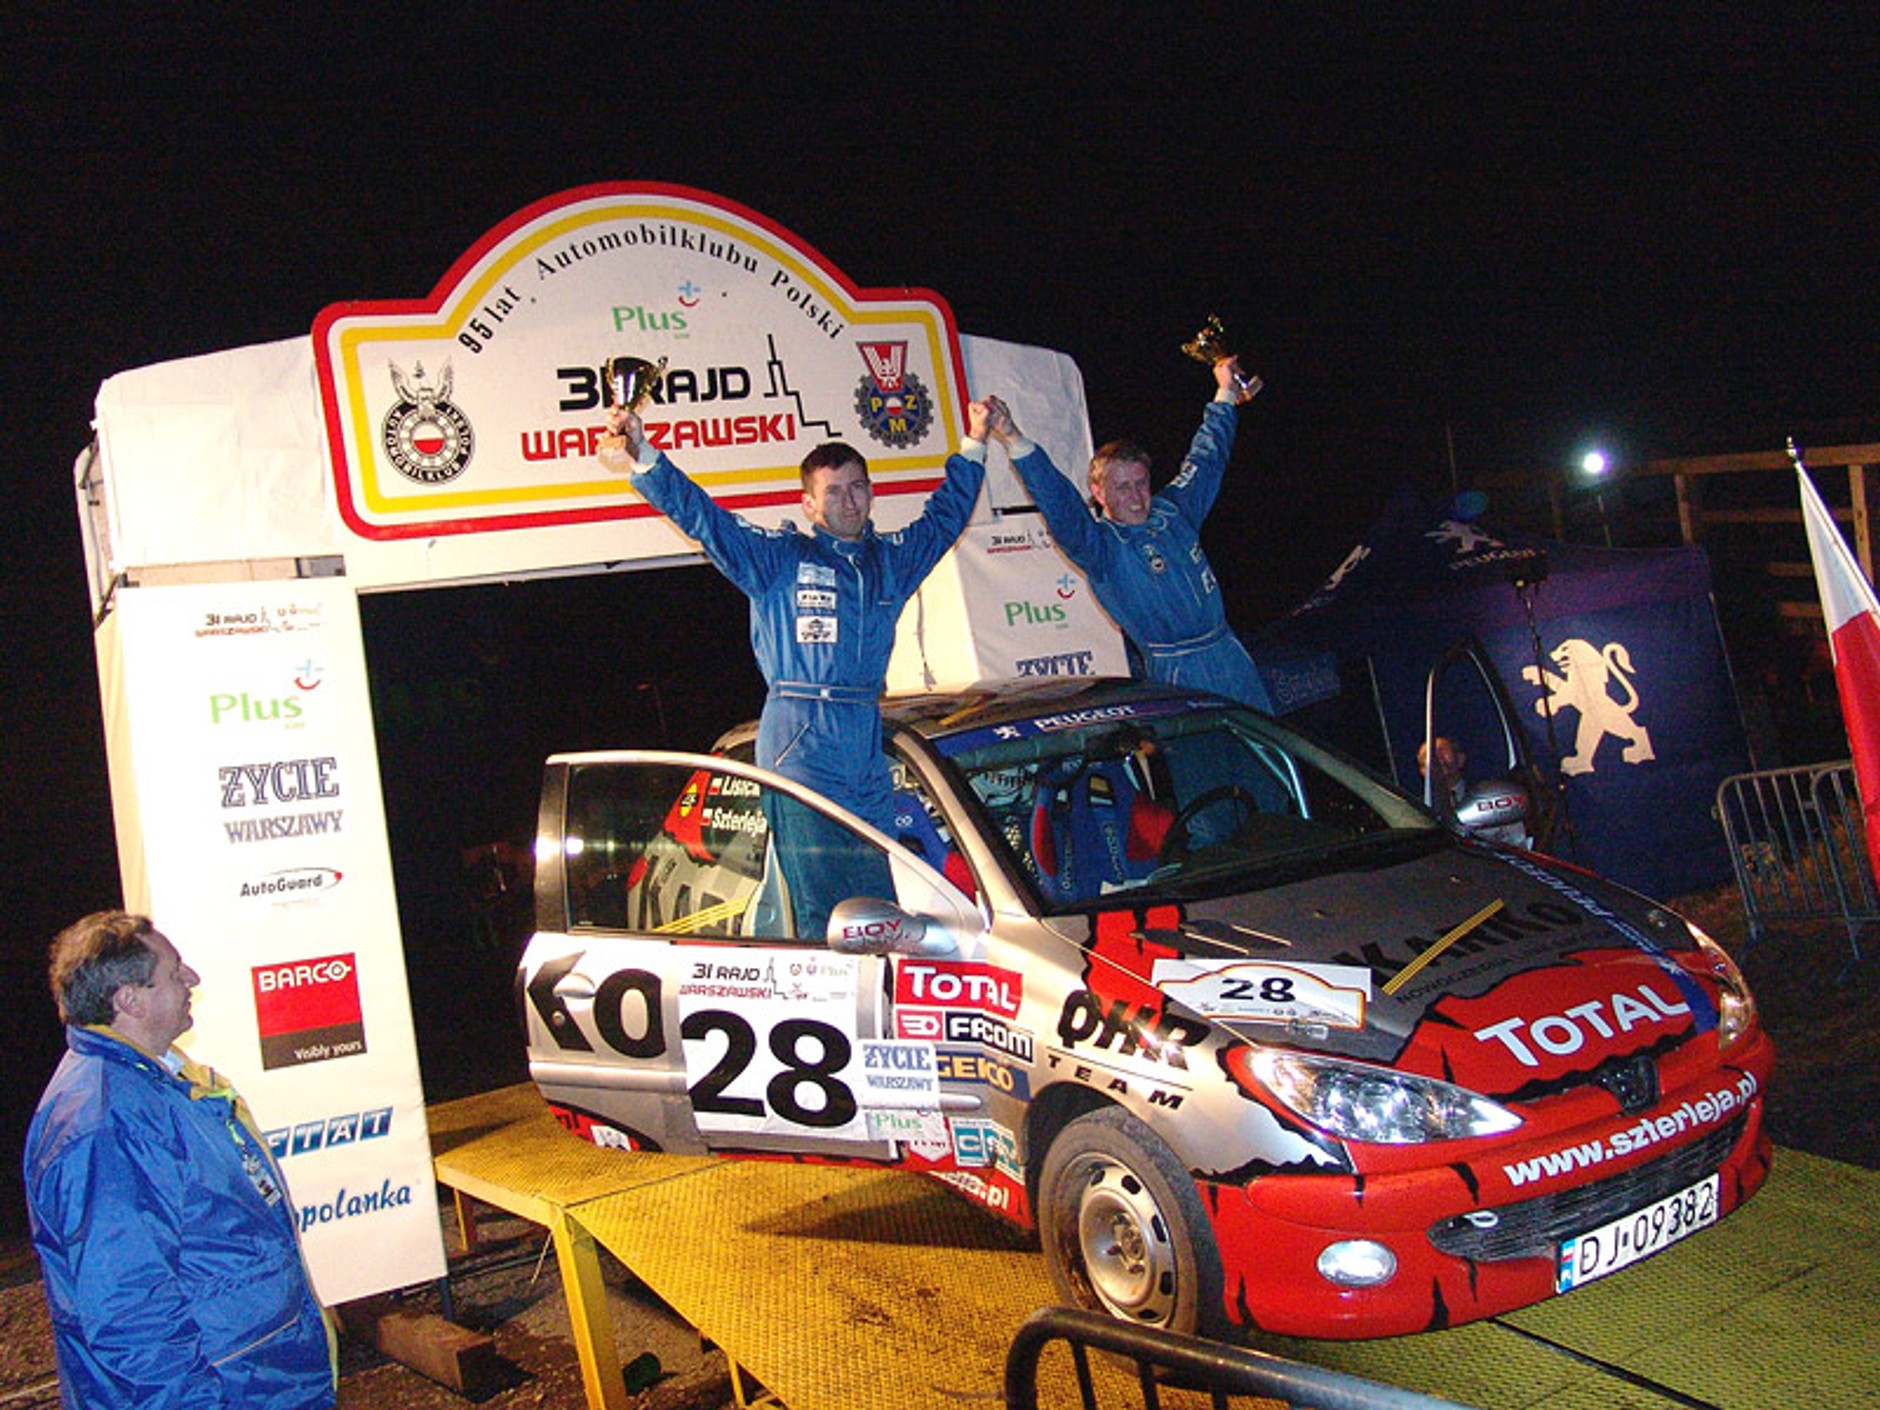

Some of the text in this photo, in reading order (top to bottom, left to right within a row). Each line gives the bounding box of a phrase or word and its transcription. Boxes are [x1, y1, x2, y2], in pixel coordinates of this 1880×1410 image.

[458, 223, 845, 355] 95 lat Automobilklubu Polski
[611, 304, 687, 333] Plus
[1004, 601, 1067, 626] Plus
[209, 692, 303, 725] Plus
[1033, 705, 1136, 731] PEUGEOT
[223, 809, 344, 845] WARSZAWY
[240, 873, 323, 898] AutoGuard
[258, 960, 351, 992] BARCO
[691, 962, 760, 981] 31 RAJD
[904, 966, 1016, 1012] TOTAL
[1220, 977, 1296, 1001] 28
[949, 1017, 1031, 1059] FACOM
[1474, 984, 1691, 1067] TOTAL
[293, 1043, 330, 1061] Visibly
[680, 1009, 857, 1128] 28
[866, 1074, 933, 1091] WARSZAWY
[1048, 1055, 1184, 1110] TEAM
[875, 1112, 923, 1130] Plus
[1503, 1071, 1759, 1187] www.szterleja.pl
[295, 1179, 412, 1232] polanka
[1633, 1182, 1714, 1252] 09382
